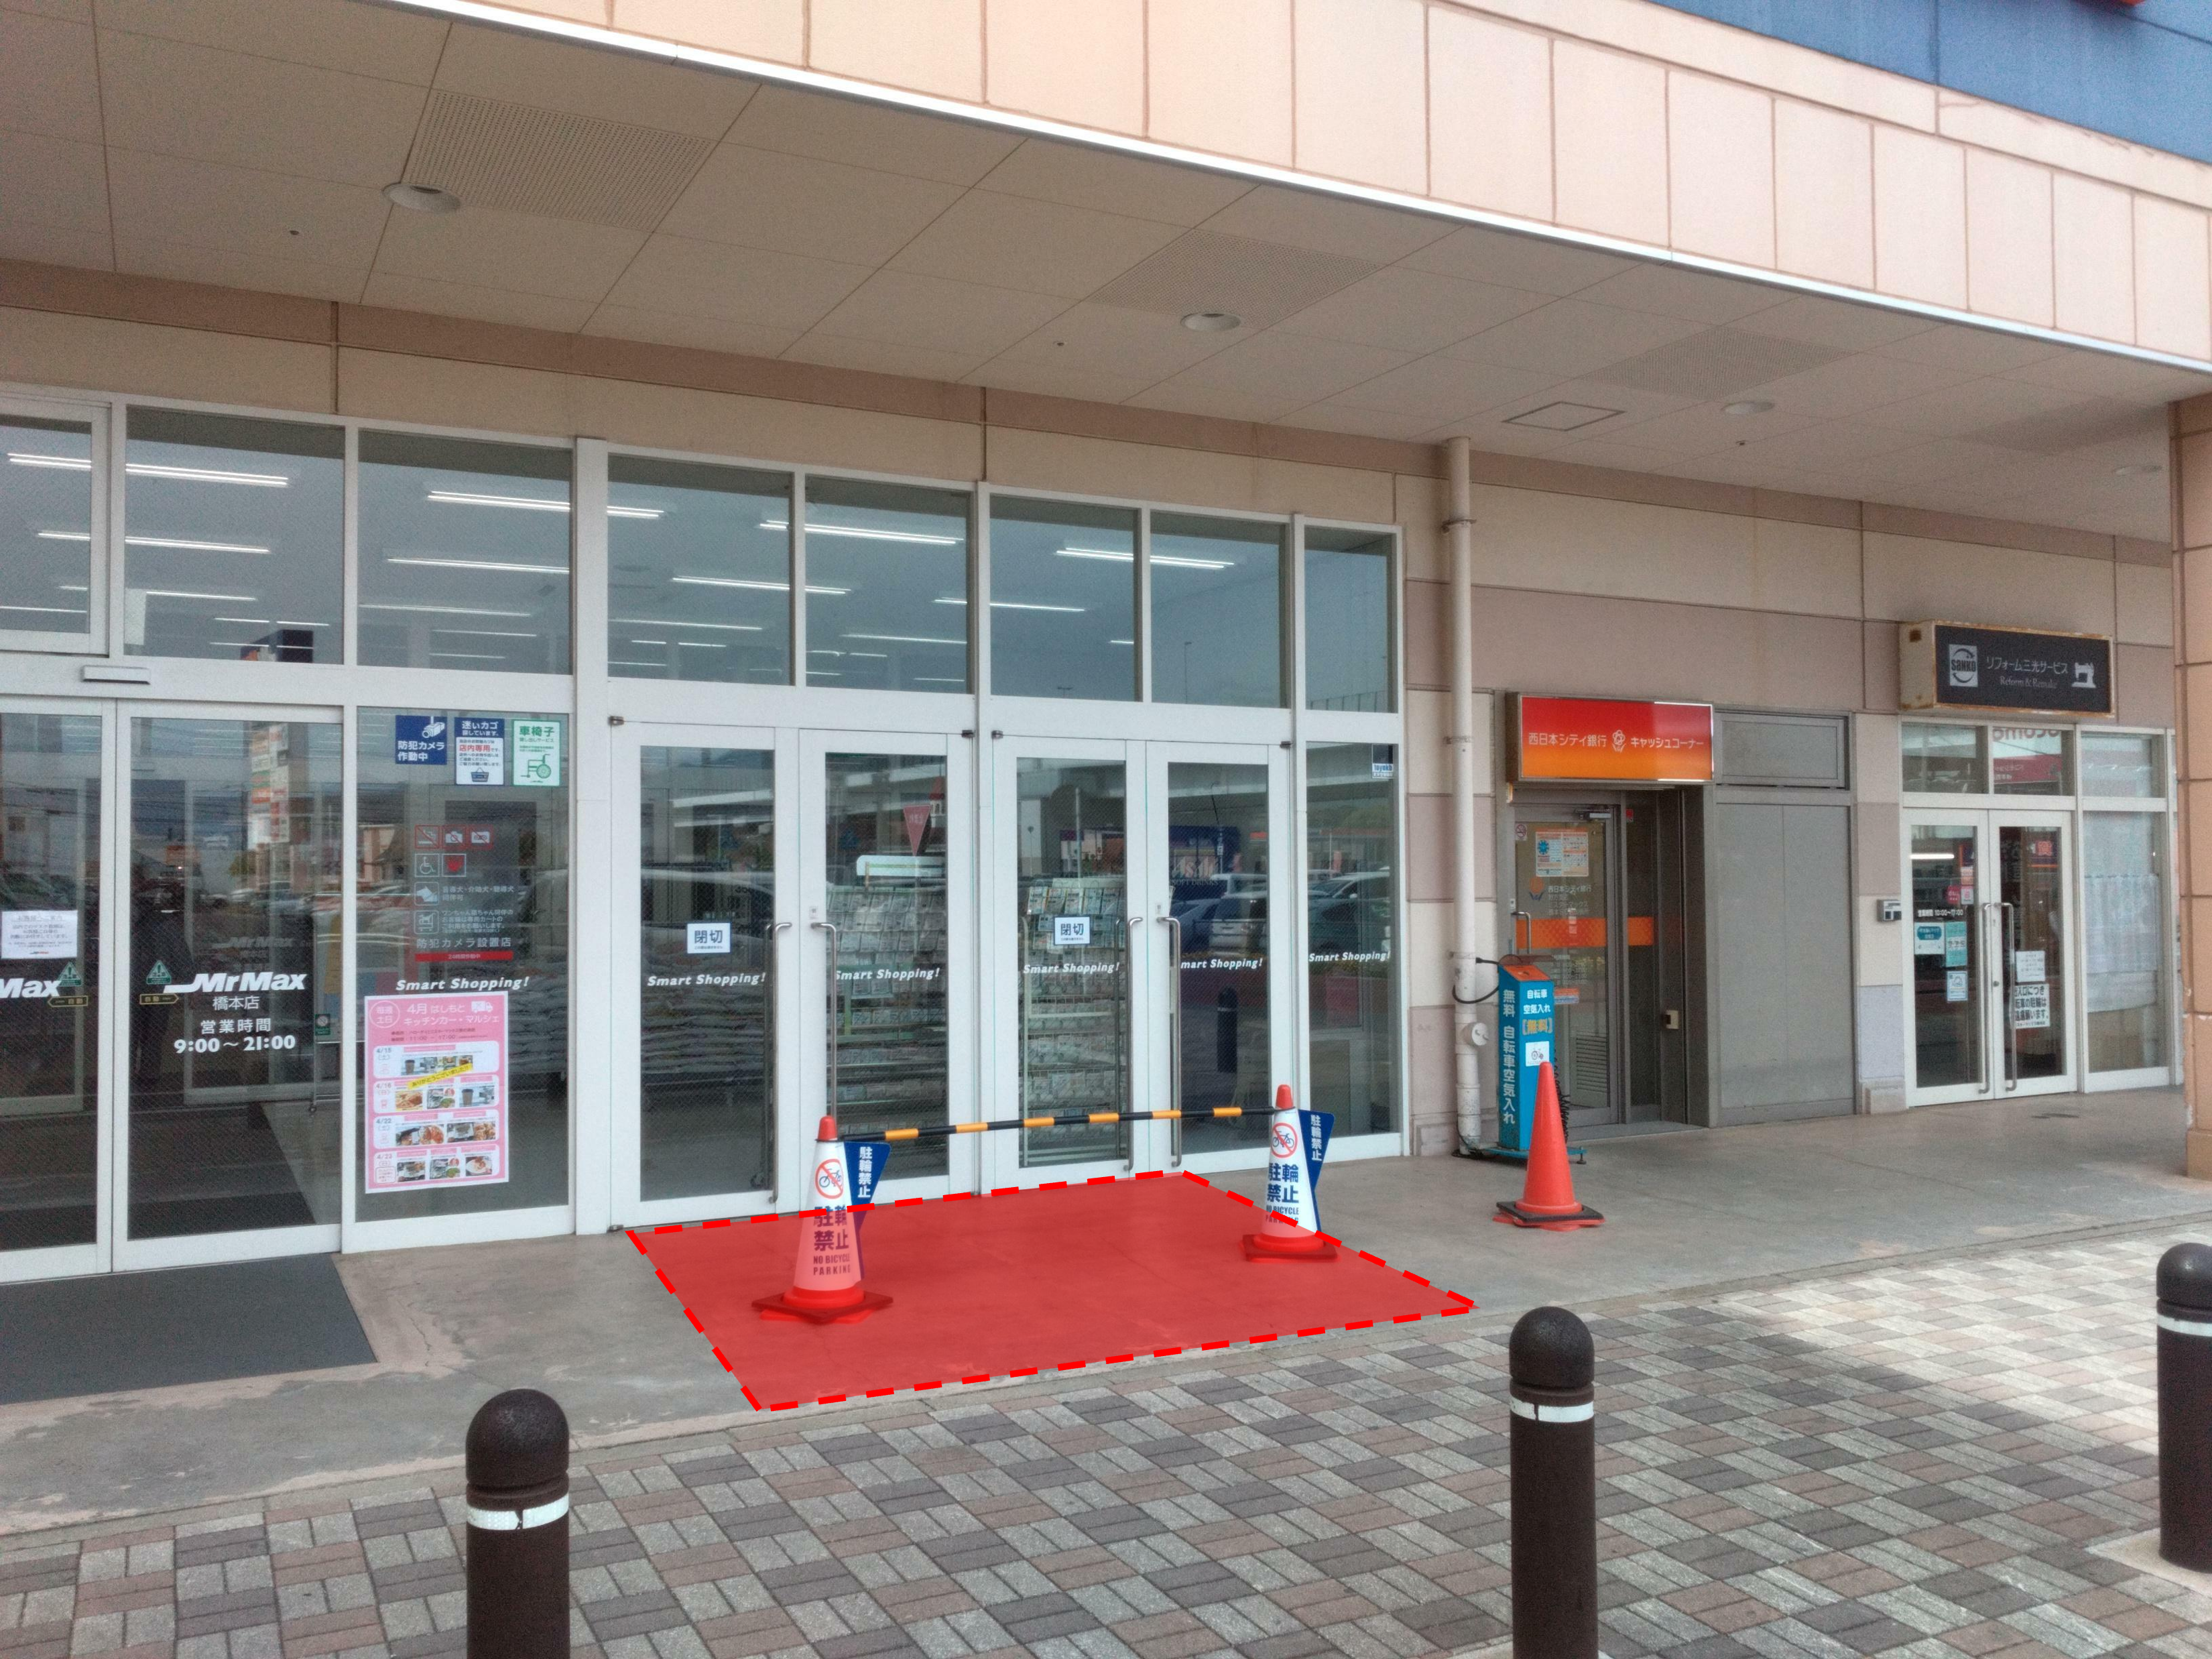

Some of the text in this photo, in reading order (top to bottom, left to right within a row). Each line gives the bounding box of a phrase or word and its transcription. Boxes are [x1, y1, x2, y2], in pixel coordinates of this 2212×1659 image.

[1987, 656, 2068, 674] リフォーム三光サービス
[462, 721, 499, 729] 迷いカゴ
[519, 726, 554, 737] 車椅子
[397, 741, 445, 750] 防犯カメラ
[1529, 732, 1607, 747] 西日本シティ銀行
[1631, 737, 1703, 749] キャッシュコーナー
[397, 751, 428, 761] 作動中
[1060, 924, 1084, 936] 閉切
[417, 937, 511, 948] 防犯カメラ設置店
[694, 930, 723, 943] 閉切
[1308, 950, 1391, 962] Smart Shopping!
[1024, 962, 1120, 974] Smart Shopping!
[1180, 958, 1263, 970] mart Shopping!
[647, 973, 765, 986] Smart Shopping!
[877, 967, 940, 981] Shopping!
[164, 971, 307, 993] MrMax
[395, 976, 530, 991] Smart Shopping!
[1527, 989, 1548, 999] 自転車
[212, 995, 260, 1011] 橋本店
[407, 1003, 465, 1015] 4月 はしもと
[1503, 989, 1516, 1018] 無料
[1524, 1004, 1550, 1015] 空気入れ
[201, 1018, 271, 1034] 営業時間
[377, 1016, 393, 1024] 土日
[404, 1016, 499, 1026] キッチンカー・マルシェ
[1503, 1026, 1516, 1124] 自転車空気入れ
[1310, 1114, 1323, 1162] 駐輪禁止
[858, 1146, 873, 1199] 駐輪禁止
[1268, 1162, 1299, 1183] 駐輪
[1267, 1183, 1299, 1203] 禁止
[813, 1205, 847, 1227] 駐輪
[1273, 1205, 1299, 1215] BICYCLE
[814, 1229, 849, 1251] 禁止
[813, 1255, 824, 1264] NO
[813, 1264, 851, 1276] PARKING
